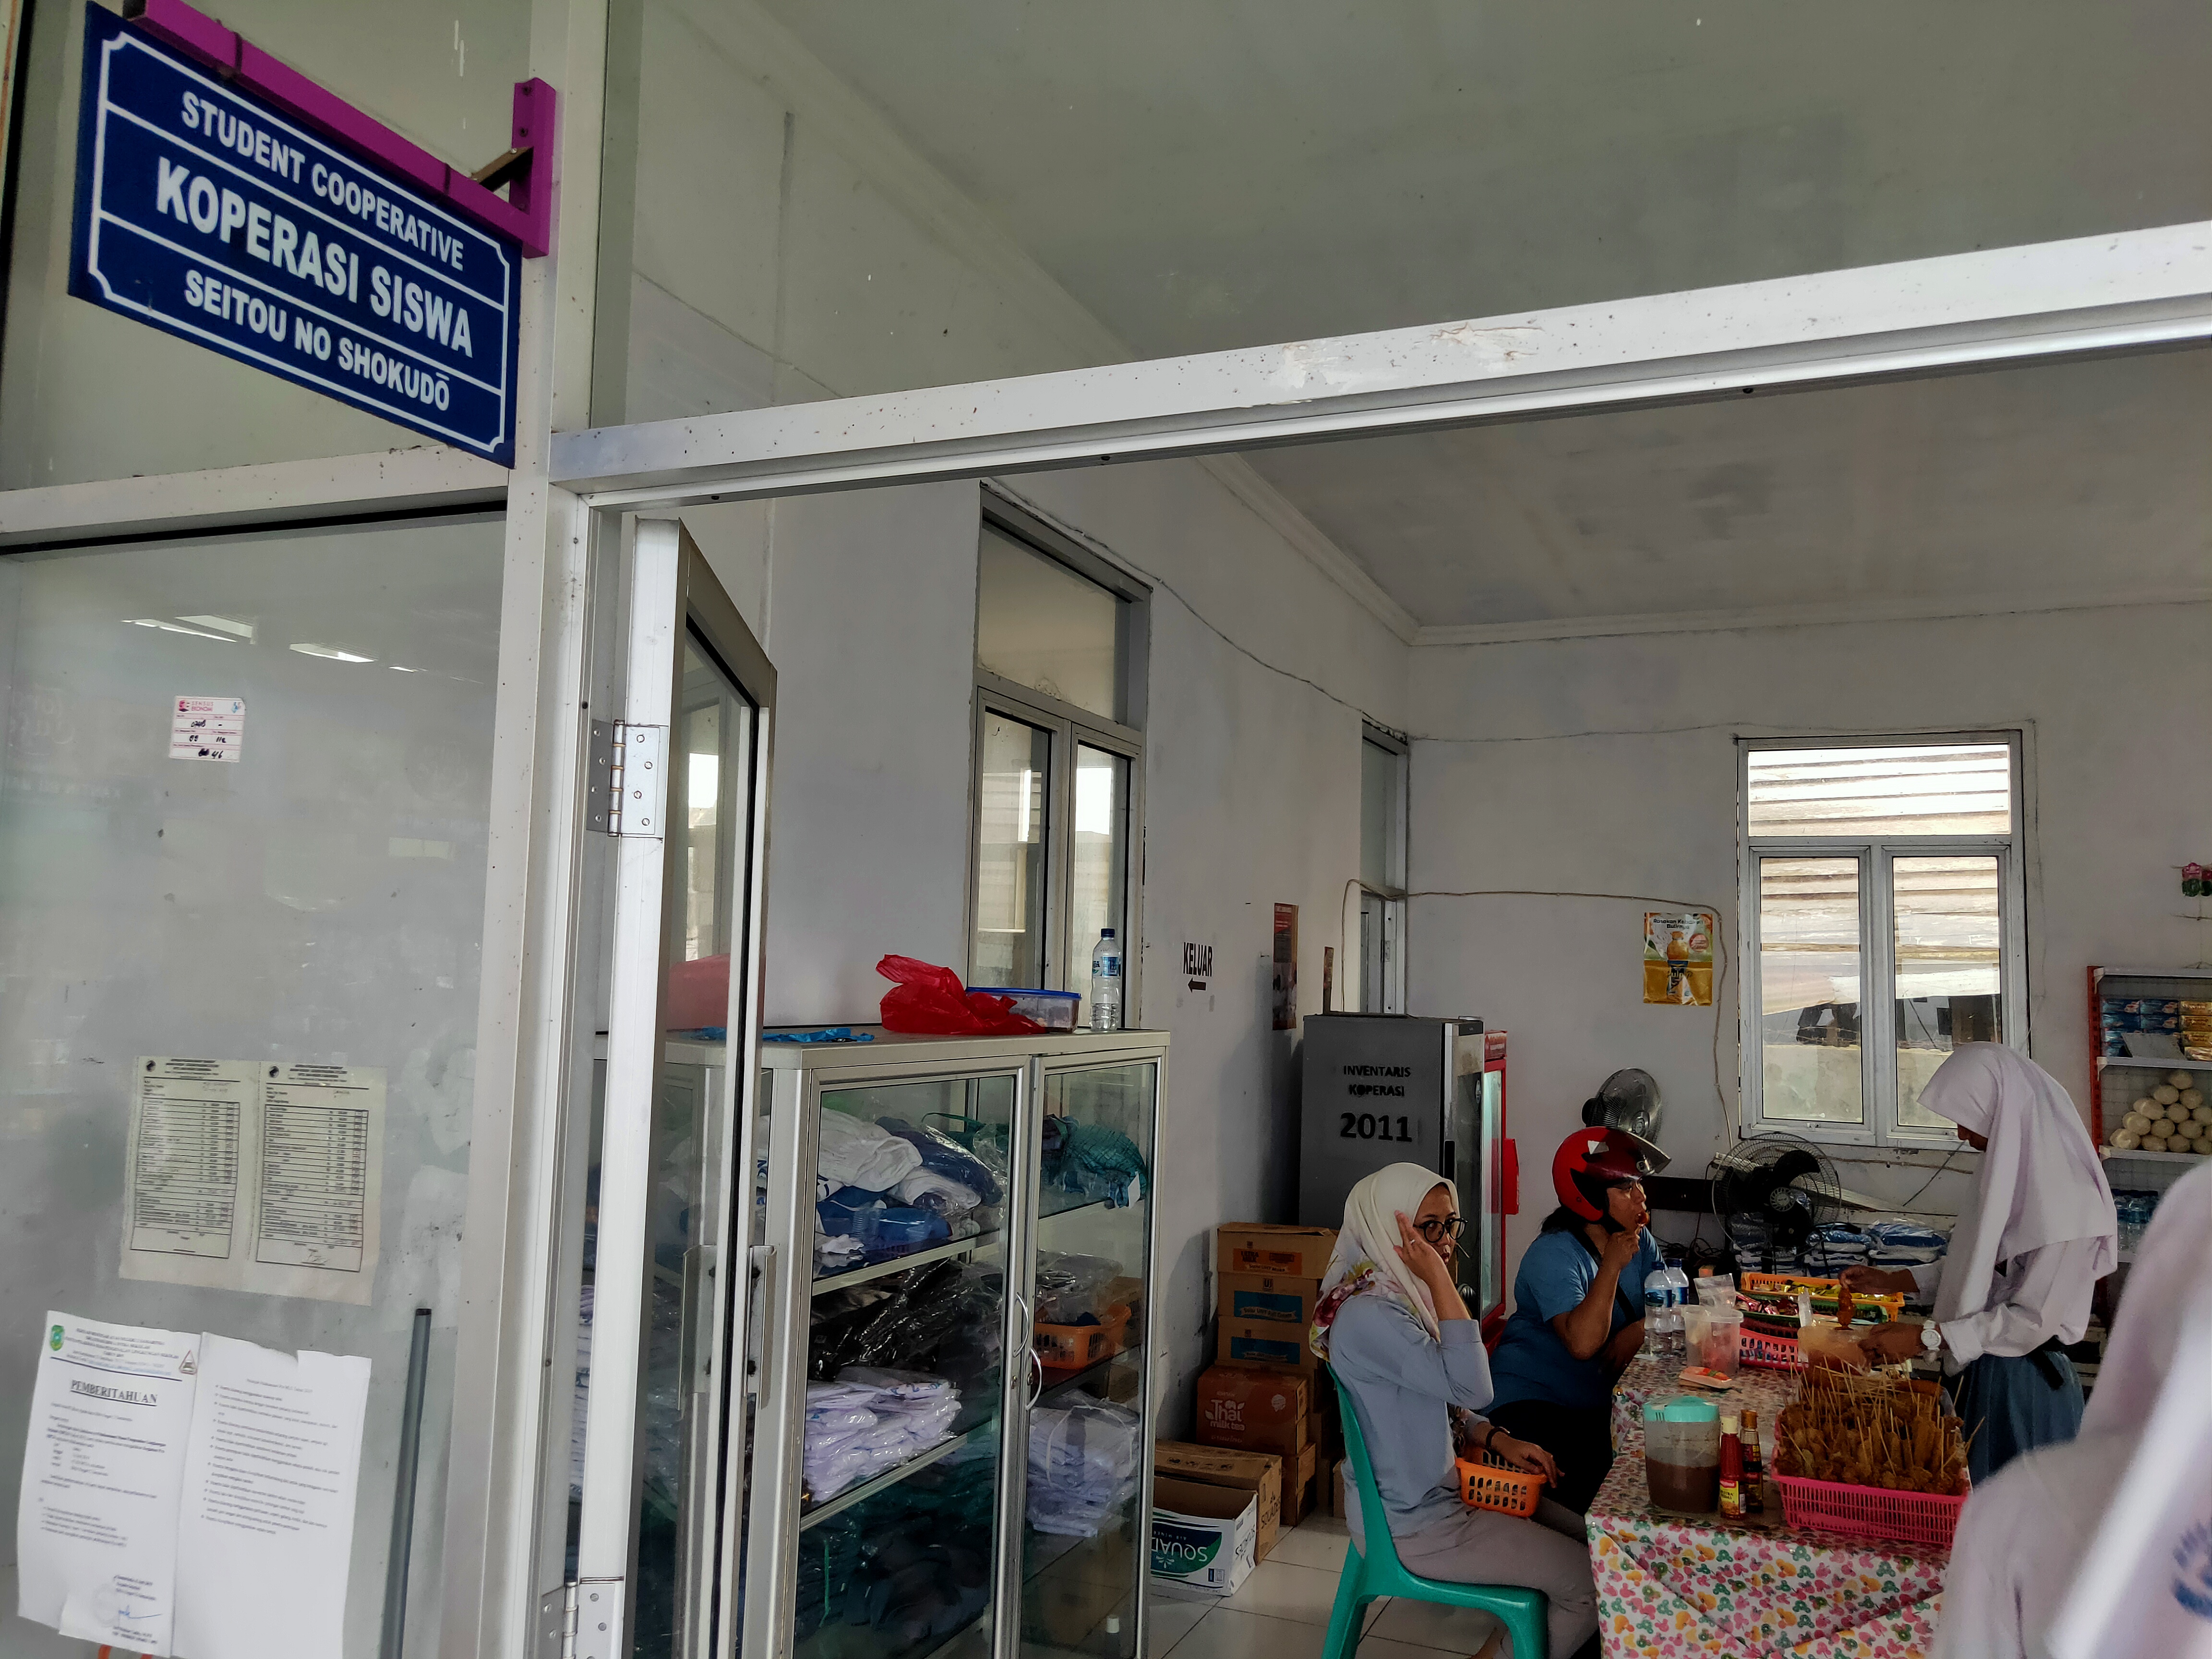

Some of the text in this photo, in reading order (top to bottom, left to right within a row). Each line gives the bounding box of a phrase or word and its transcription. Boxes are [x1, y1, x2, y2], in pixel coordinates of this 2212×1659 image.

[183, 92, 464, 271] STUDENT COOPERATIVE
[157, 156, 472, 358] KOPERASI SISWA
[184, 269, 449, 411] SEITOU NO SHOKUDŌ
[1183, 942, 1213, 976] KELUAR
[1344, 1066, 1411, 1077] INVENTARIS
[1349, 1084, 1405, 1096] KOPERASI
[1340, 1112, 1412, 1142] 2011
[72, 1380, 157, 1404] PEMBERITAHUAN
[1211, 1399, 1242, 1422] Thai
[1210, 1420, 1230, 1429] milk
